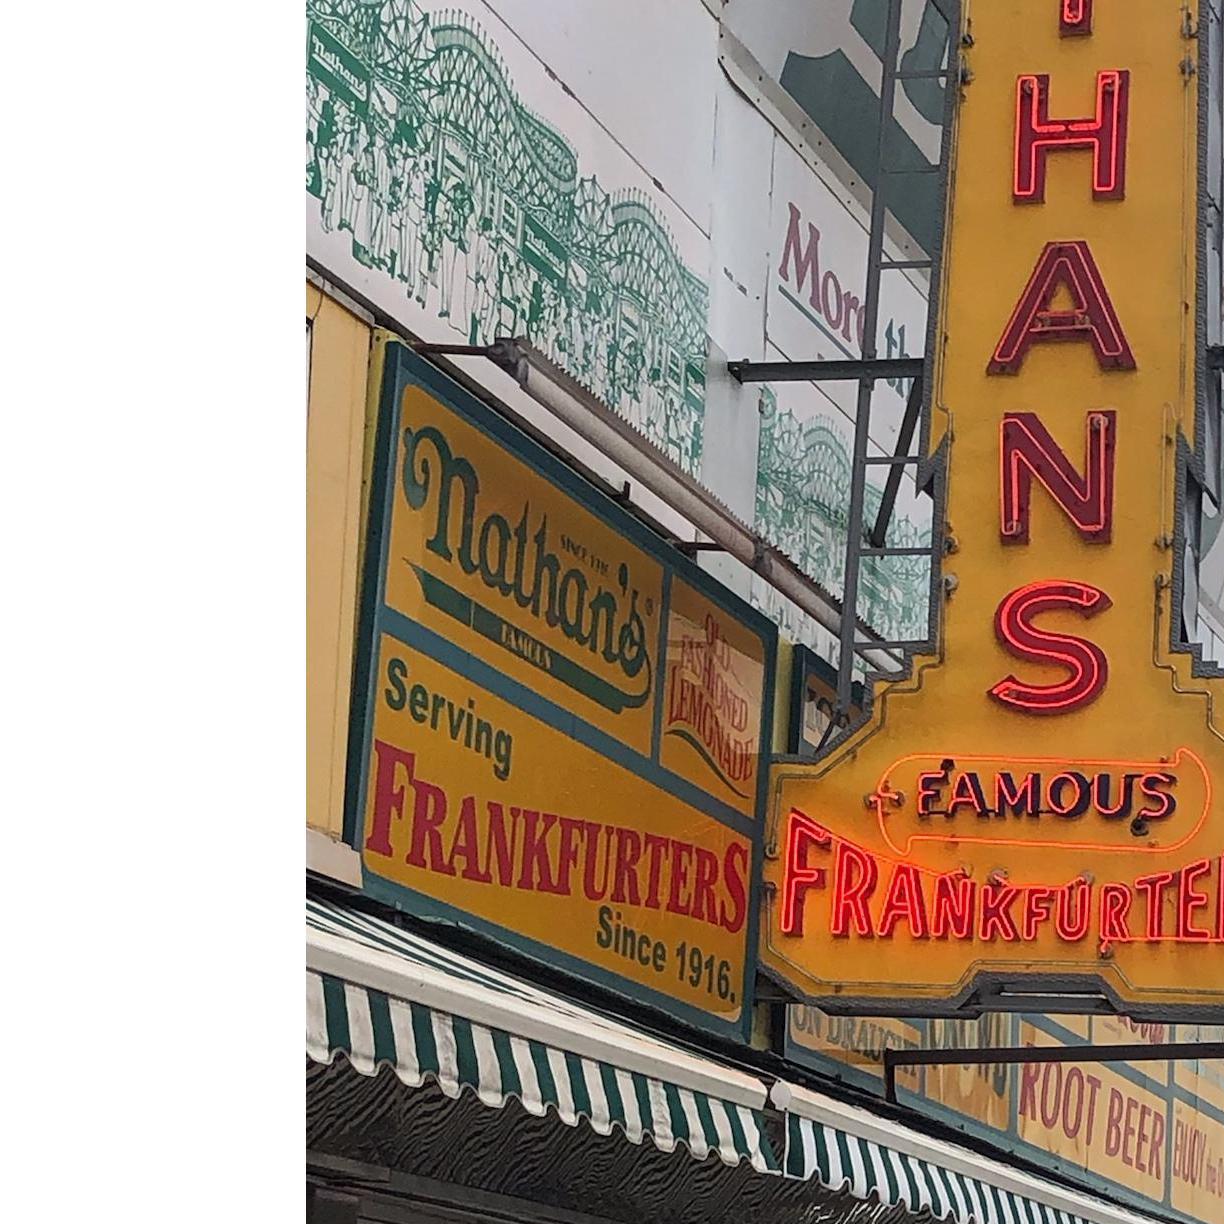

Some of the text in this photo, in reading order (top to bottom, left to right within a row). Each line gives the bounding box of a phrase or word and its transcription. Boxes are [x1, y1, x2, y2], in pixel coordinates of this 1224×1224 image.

[385, 658, 512, 781] Serving
[668, 665, 754, 782] LEMONADE
[366, 738, 749, 934] FRANKFURTERS
[916, 770, 1178, 822] FAMOUS
[596, 905, 736, 1004] Since 1916.
[1019, 1042, 1101, 1146] ROOT
[1105, 1087, 1164, 1180] BEER
